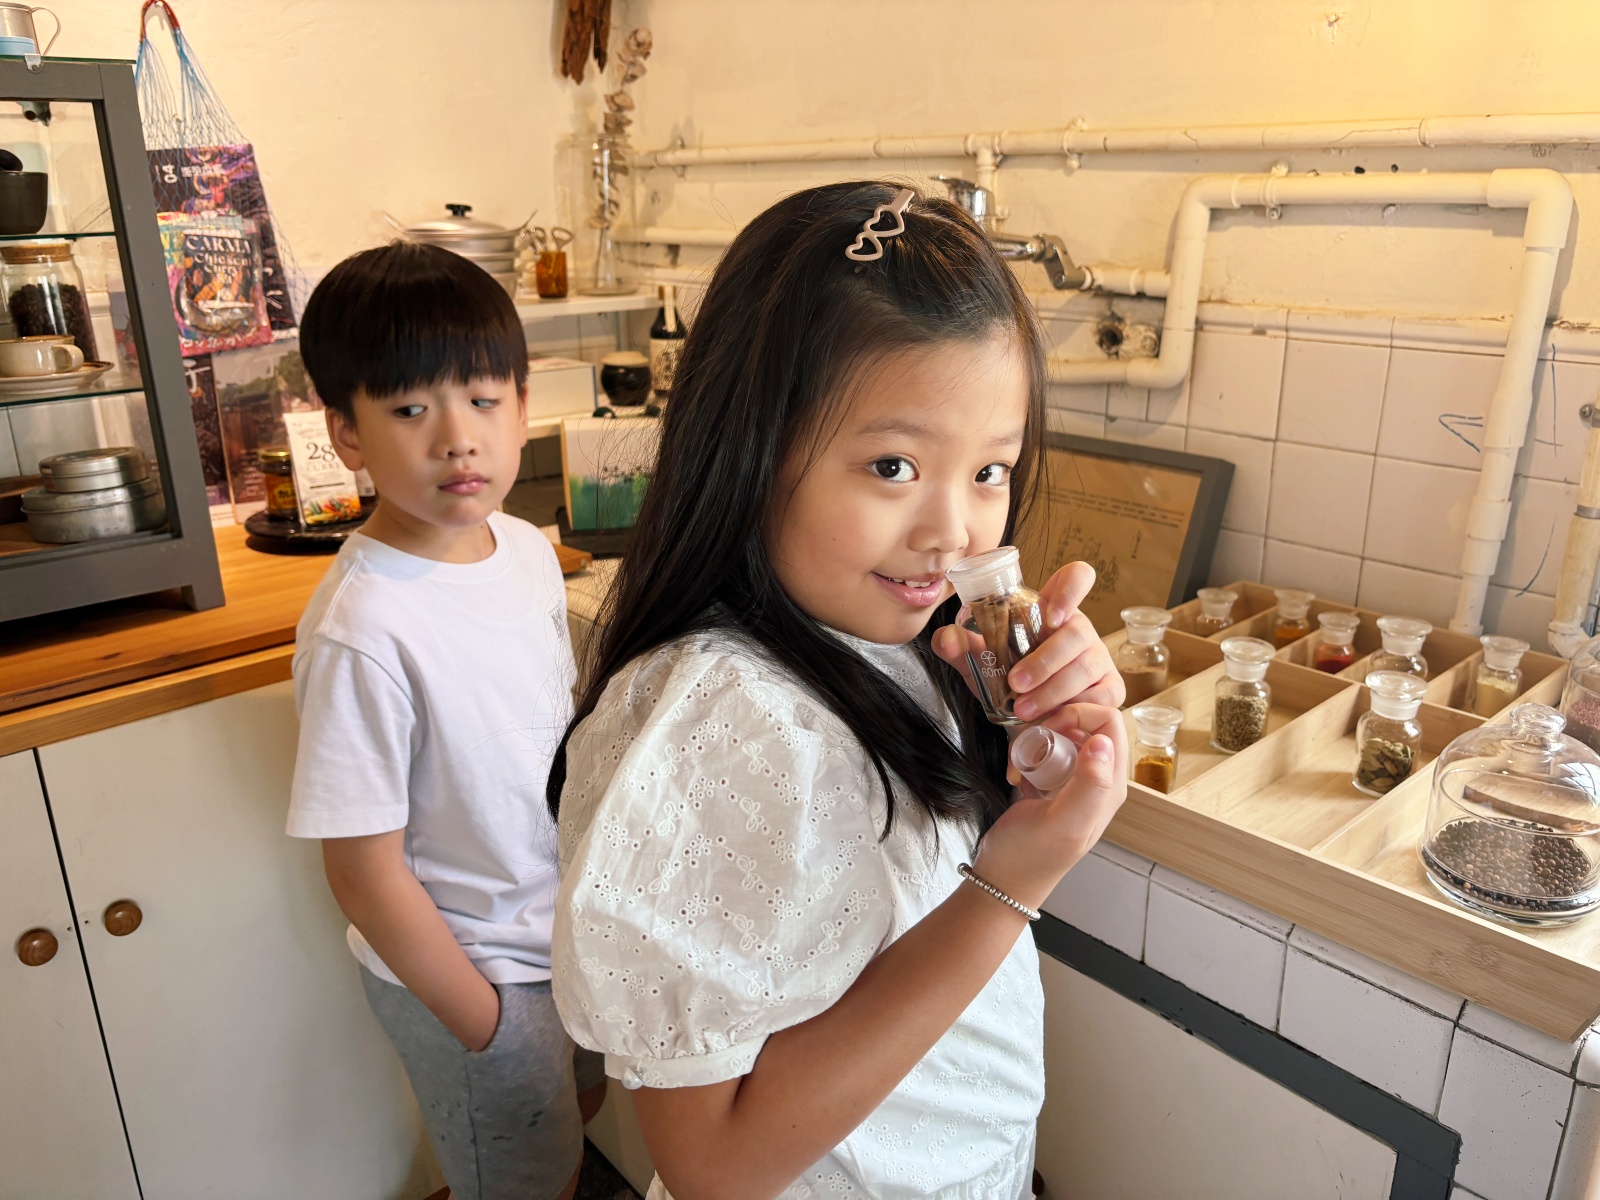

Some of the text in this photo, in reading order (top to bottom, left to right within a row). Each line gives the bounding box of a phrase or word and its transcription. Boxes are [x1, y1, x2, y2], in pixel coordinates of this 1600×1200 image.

[194, 252, 249, 266] Chicken
[203, 264, 238, 279] Curry
[306, 442, 335, 462] 28
[981, 664, 1007, 678] 60ml
